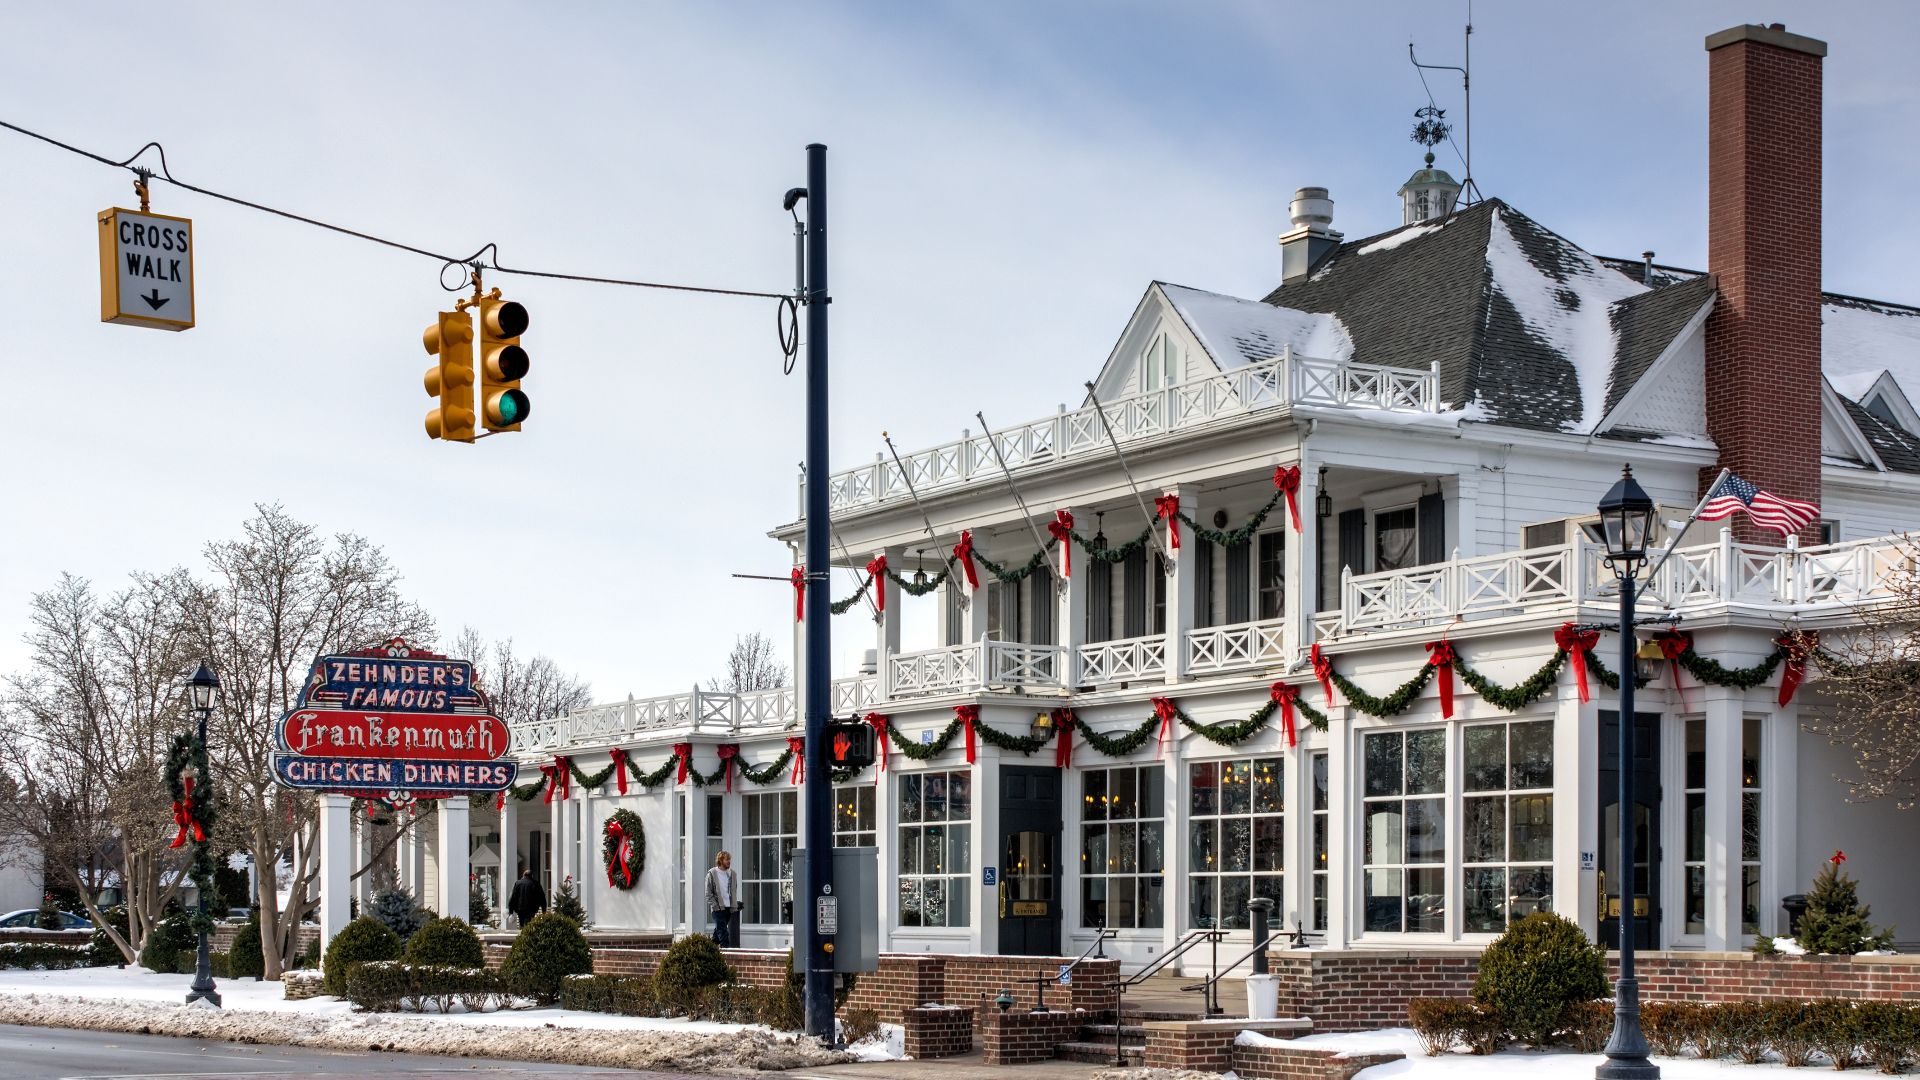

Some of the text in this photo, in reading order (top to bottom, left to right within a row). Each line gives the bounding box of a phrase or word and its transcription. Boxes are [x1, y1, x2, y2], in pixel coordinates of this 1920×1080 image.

[120, 221, 188, 252] CROSS
[126, 253, 182, 282] WALK
[332, 662, 464, 686] ZEHNDER'S
[349, 687, 447, 709] FAMOUS
[296, 713, 496, 758] Frankenmuth
[287, 761, 507, 785] CHICKEN DINNERS
